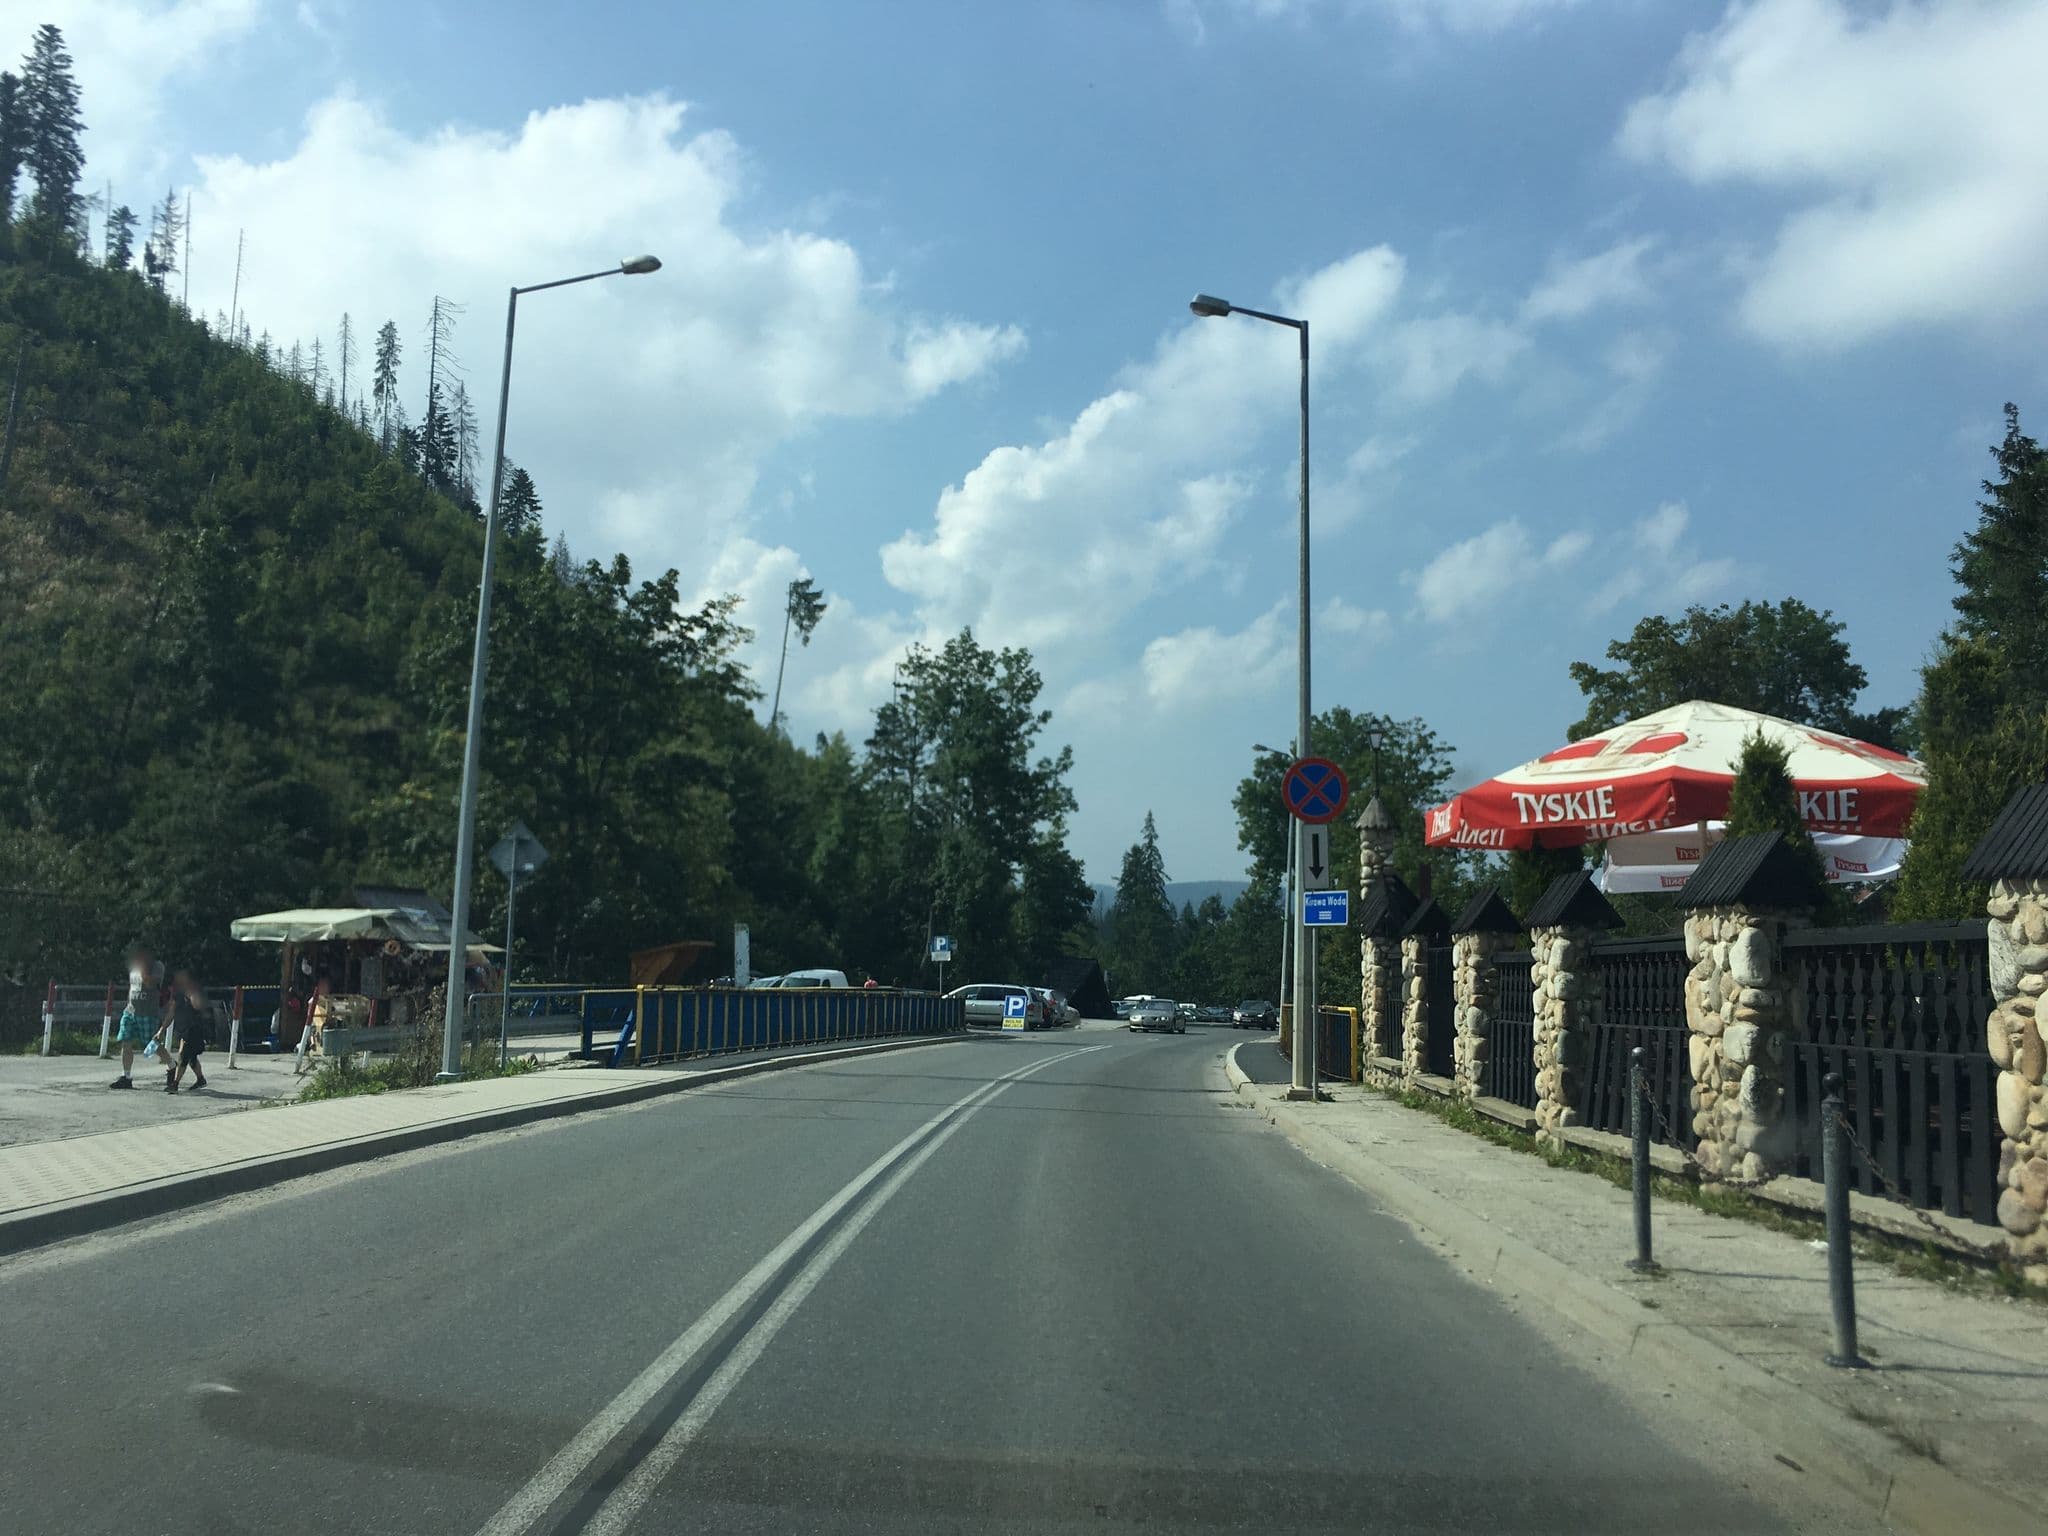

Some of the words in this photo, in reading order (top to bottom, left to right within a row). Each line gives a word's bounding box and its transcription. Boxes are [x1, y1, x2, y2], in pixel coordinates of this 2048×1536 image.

[1511, 785, 1616, 824] TYSKIE
[1793, 788, 1858, 821] KIE
[1327, 896, 1345, 906] Woda
[936, 937, 946, 951] P
[1008, 997, 1023, 1016] P
